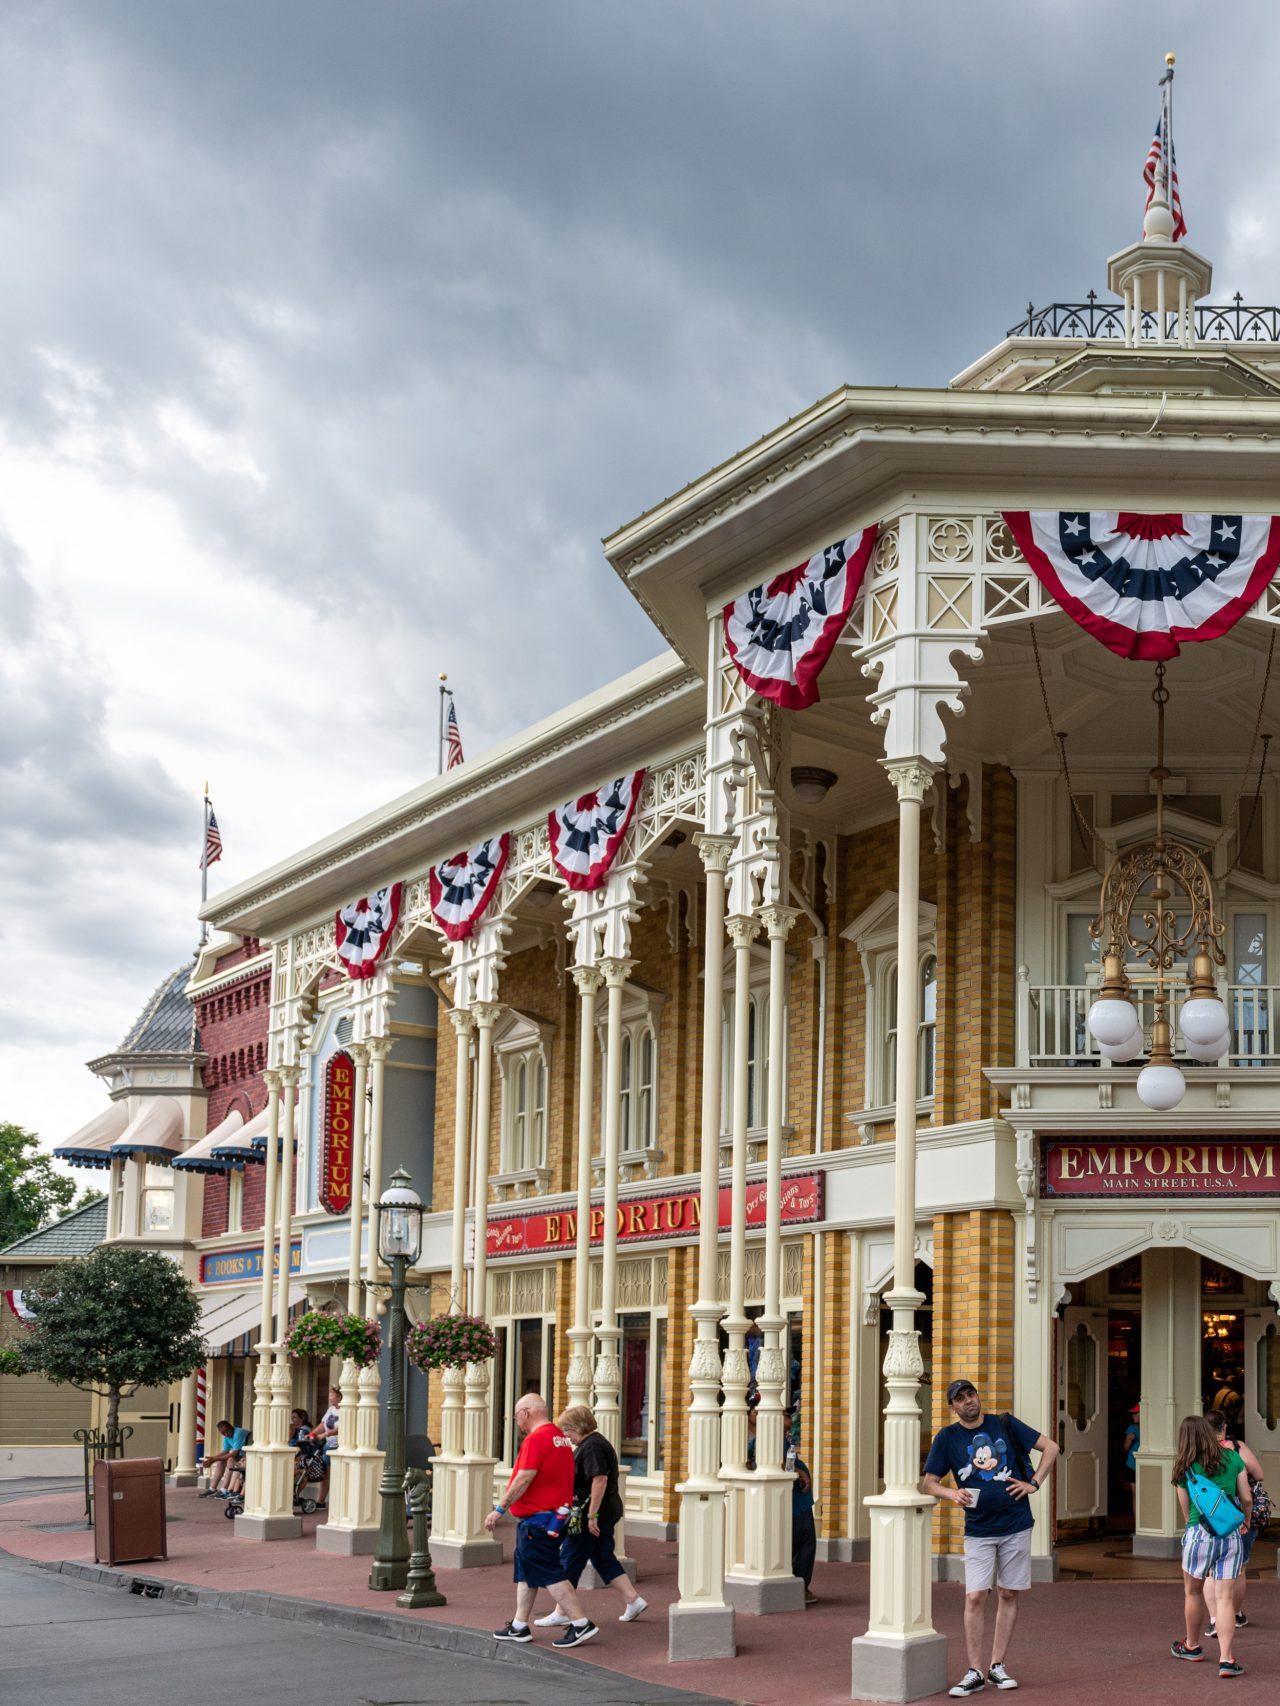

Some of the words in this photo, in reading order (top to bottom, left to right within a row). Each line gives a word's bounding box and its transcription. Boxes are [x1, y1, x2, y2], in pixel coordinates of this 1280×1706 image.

[330, 1068, 352, 1197] EMPORIUM
[1058, 1146, 1277, 1179] EMPORIUM
[1103, 1178, 1140, 1188] MAIN
[1202, 1178, 1238, 1188] U.S.A.
[746, 1197, 759, 1215] Dry
[779, 1185, 799, 1209] otions
[790, 1197, 796, 1209] &
[215, 1258, 244, 1276] BOOKS
